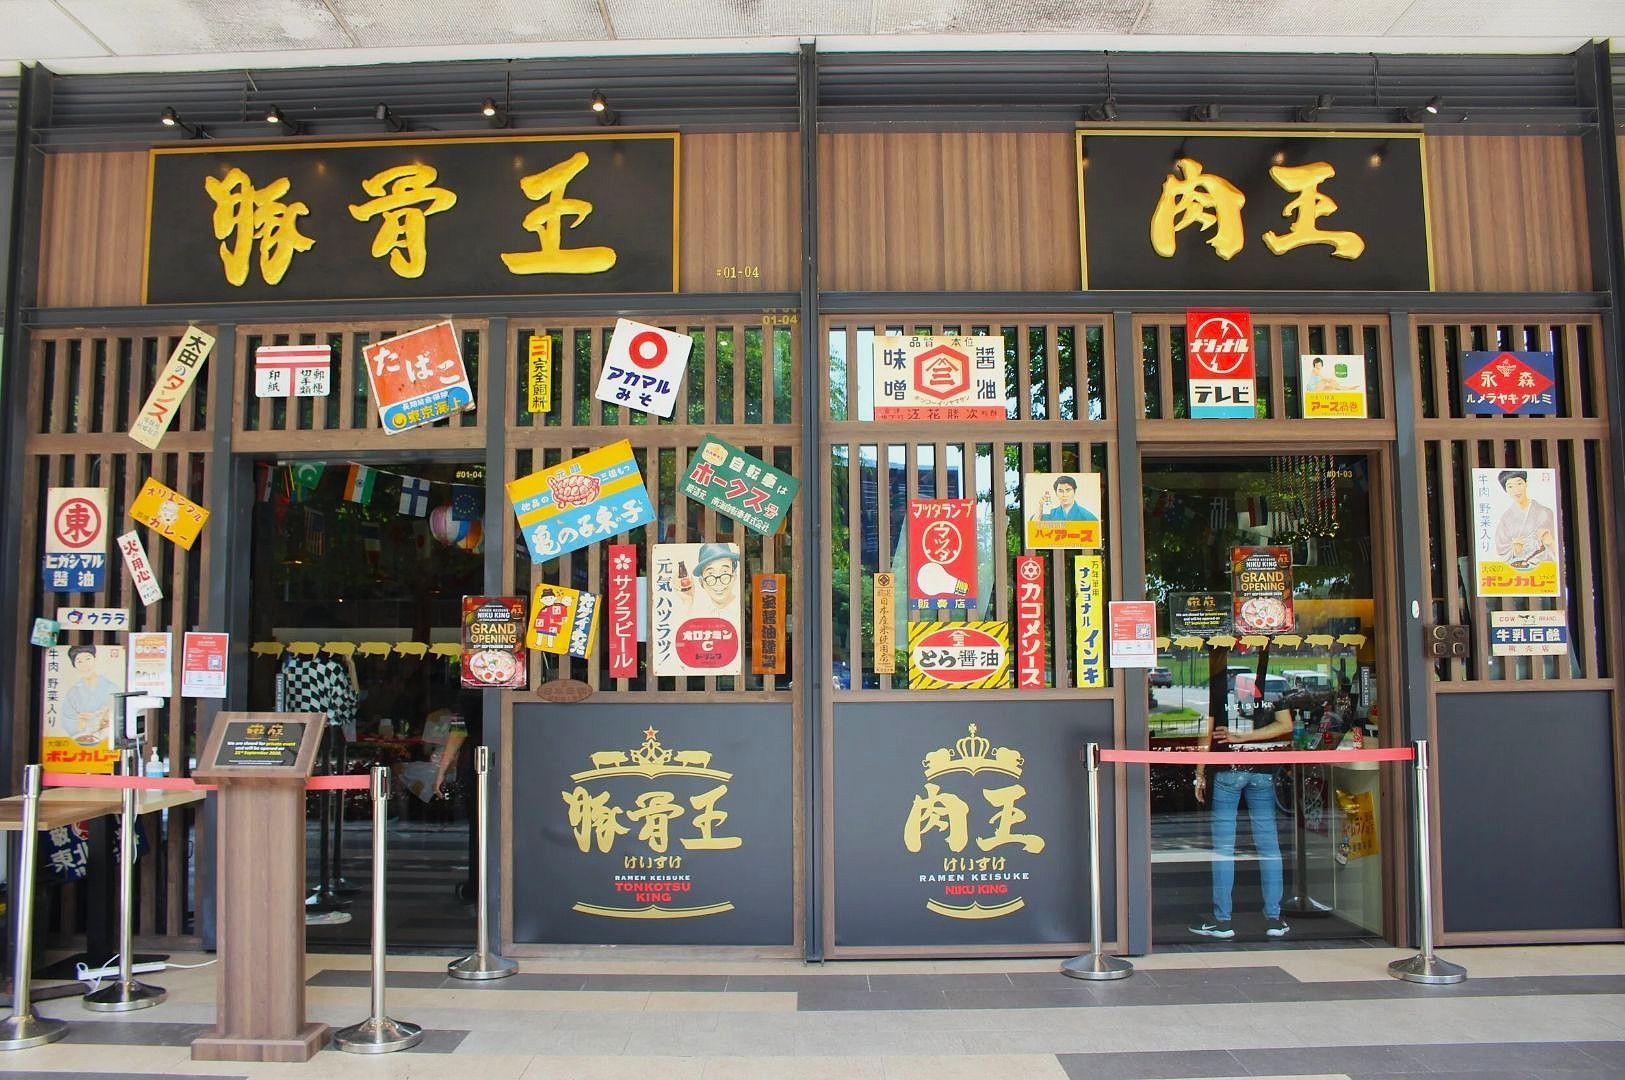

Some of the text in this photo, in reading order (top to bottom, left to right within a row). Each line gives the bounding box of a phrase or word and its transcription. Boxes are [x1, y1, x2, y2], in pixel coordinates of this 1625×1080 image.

[1150, 157, 1366, 261] 肉王
[205, 151, 617, 287] 豚骨王
[716, 265, 760, 280] #01-04
[1190, 337, 1249, 353] ナショナル
[372, 347, 460, 384] たばこ
[268, 369, 281, 393] 印紙
[606, 365, 671, 395] アカマル
[884, 348, 907, 401] 味噌
[532, 358, 548, 410] 完全飼料
[616, 387, 653, 407] みそ
[1194, 386, 1249, 404] テレビ
[455, 470, 482, 479] #01-04
[690, 461, 780, 519] ホークス号
[149, 517, 189, 541] カレー
[1034, 529, 1093, 543] ハイアース
[46, 553, 105, 569] ヒガシマル
[1240, 572, 1284, 582] GRAND
[1241, 582, 1285, 592] OPENING
[87, 613, 126, 625] ウララ
[613, 575, 633, 669] サクラビール
[1079, 566, 1100, 684] ナショナル インキ
[471, 623, 517, 634] GRAND
[682, 629, 733, 641] オロナミン
[1020, 582, 1041, 686] カゴメソース
[470, 634, 517, 643] OPENING
[701, 640, 714, 652] C
[562, 784, 743, 853] 豚骨王
[903, 783, 1045, 854] 肉王
[624, 855, 682, 869] けいすけ
[943, 857, 1006, 872] けいすけ
[919, 872, 1030, 882] RAMEN KEISUKE
[614, 882, 691, 892] TONKOTSU
[945, 884, 1008, 895] NIKU KING
[636, 892, 673, 902] KING
